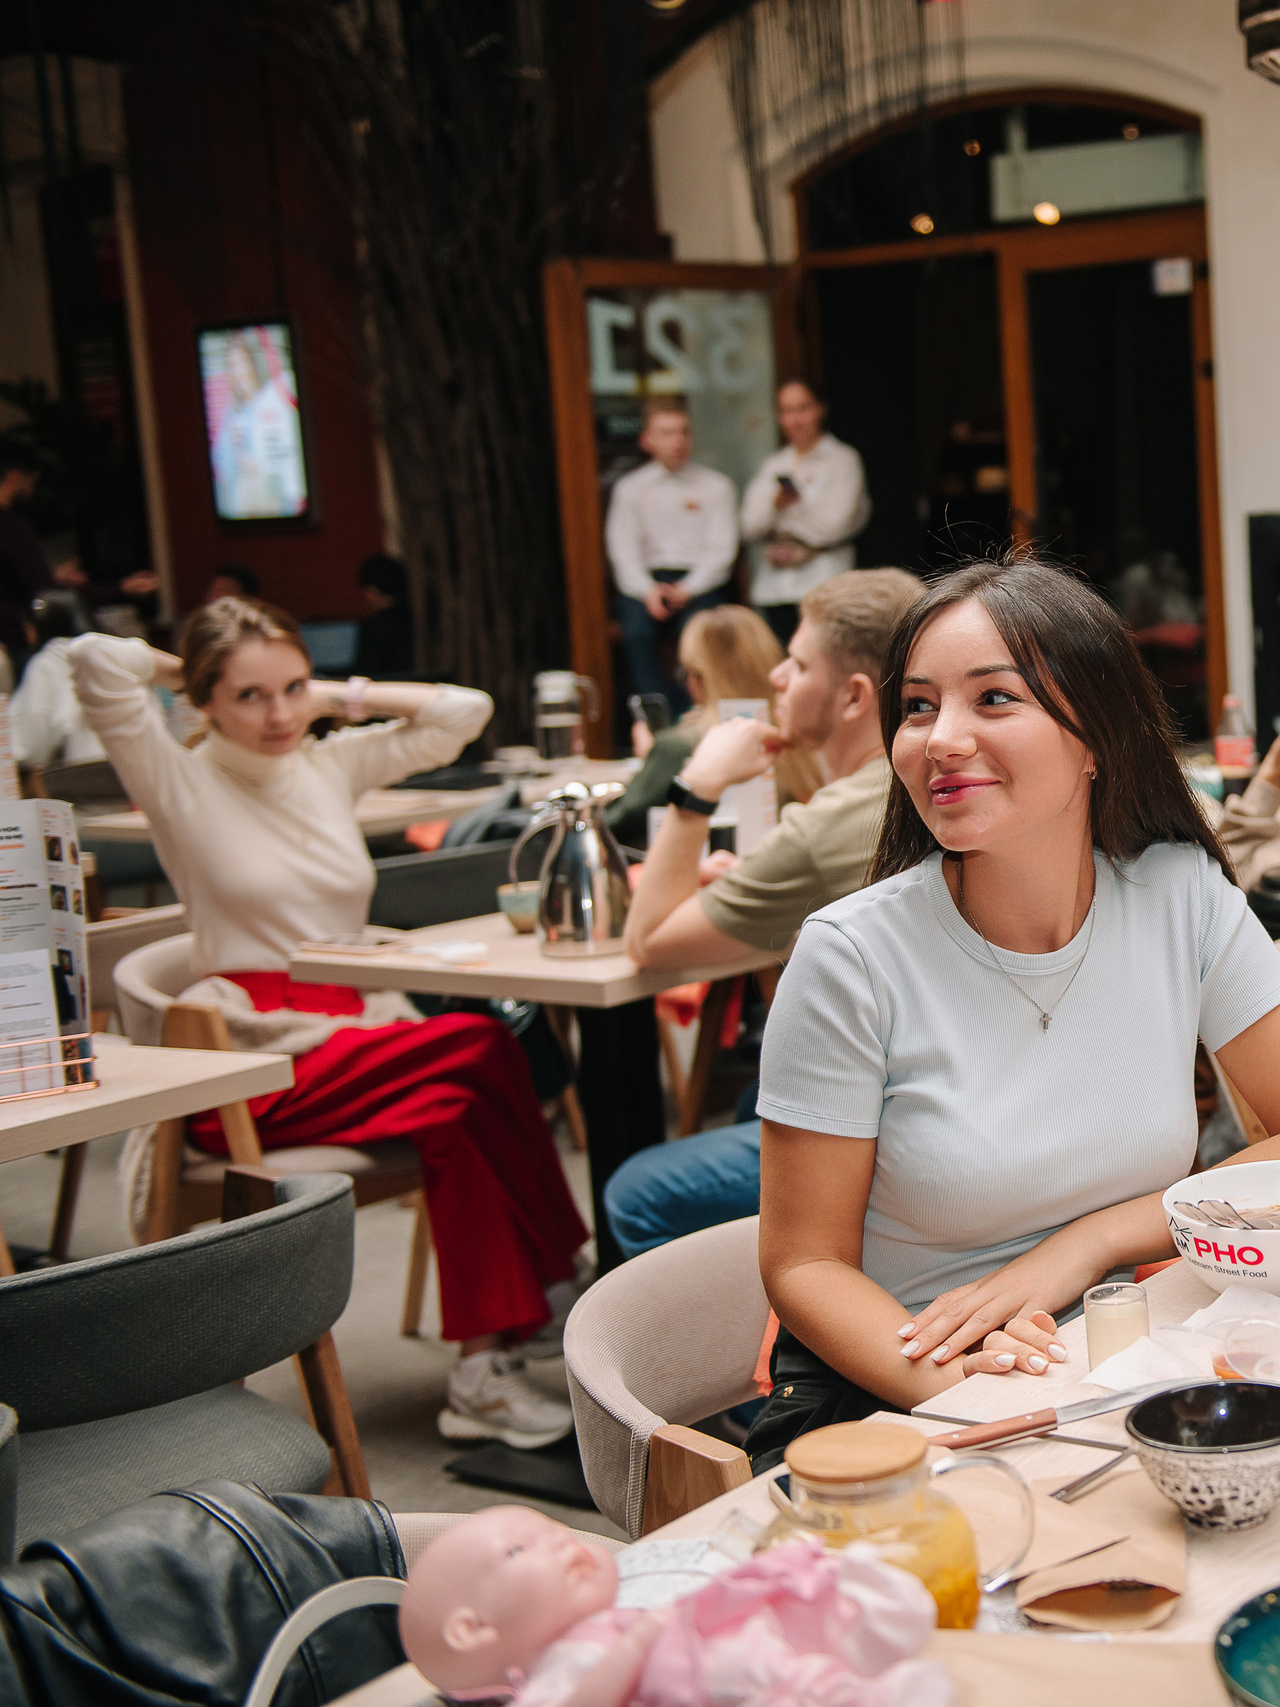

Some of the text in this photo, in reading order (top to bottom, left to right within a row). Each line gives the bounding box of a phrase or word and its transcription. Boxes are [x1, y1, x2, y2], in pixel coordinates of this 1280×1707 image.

[1193, 1237, 1265, 1266] PHO
[1214, 1265, 1241, 1277] Street
[1242, 1270, 1268, 1278] Food
